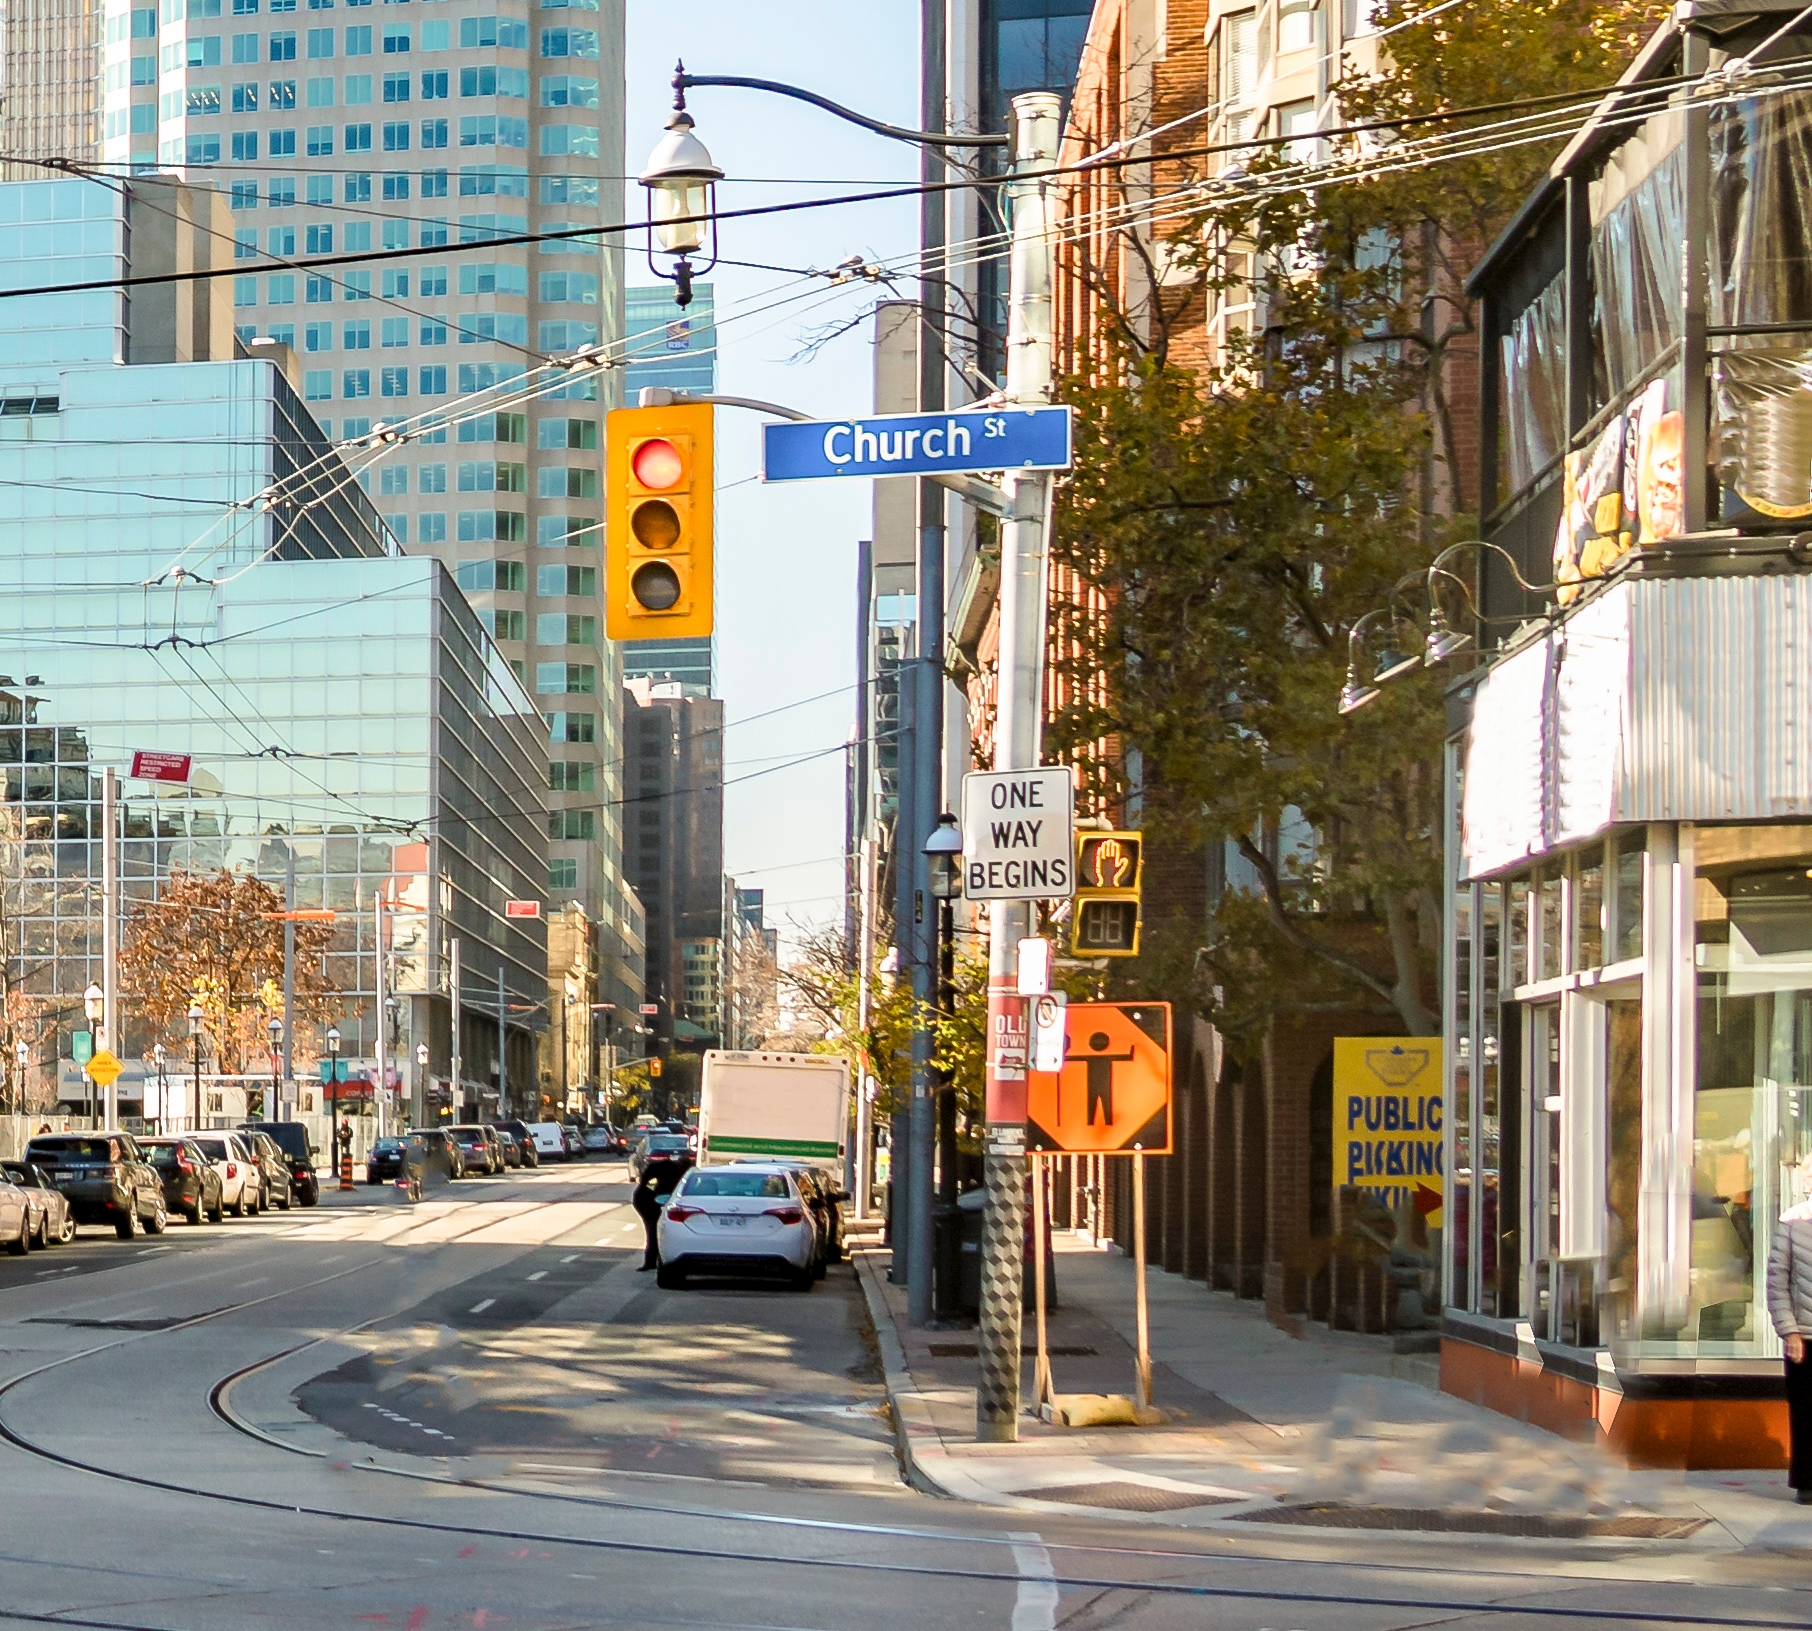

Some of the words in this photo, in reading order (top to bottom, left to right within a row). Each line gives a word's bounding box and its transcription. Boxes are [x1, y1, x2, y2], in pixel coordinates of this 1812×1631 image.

[668, 341, 689, 349] RBC
[824, 419, 971, 465] Church
[984, 417, 1007, 438] St
[991, 780, 1044, 810] ONE
[990, 820, 1043, 849] WAY
[969, 858, 1067, 890] BEGINS
[995, 1034, 1026, 1048] TOWN
[1347, 1095, 1443, 1132] PUBLIC
